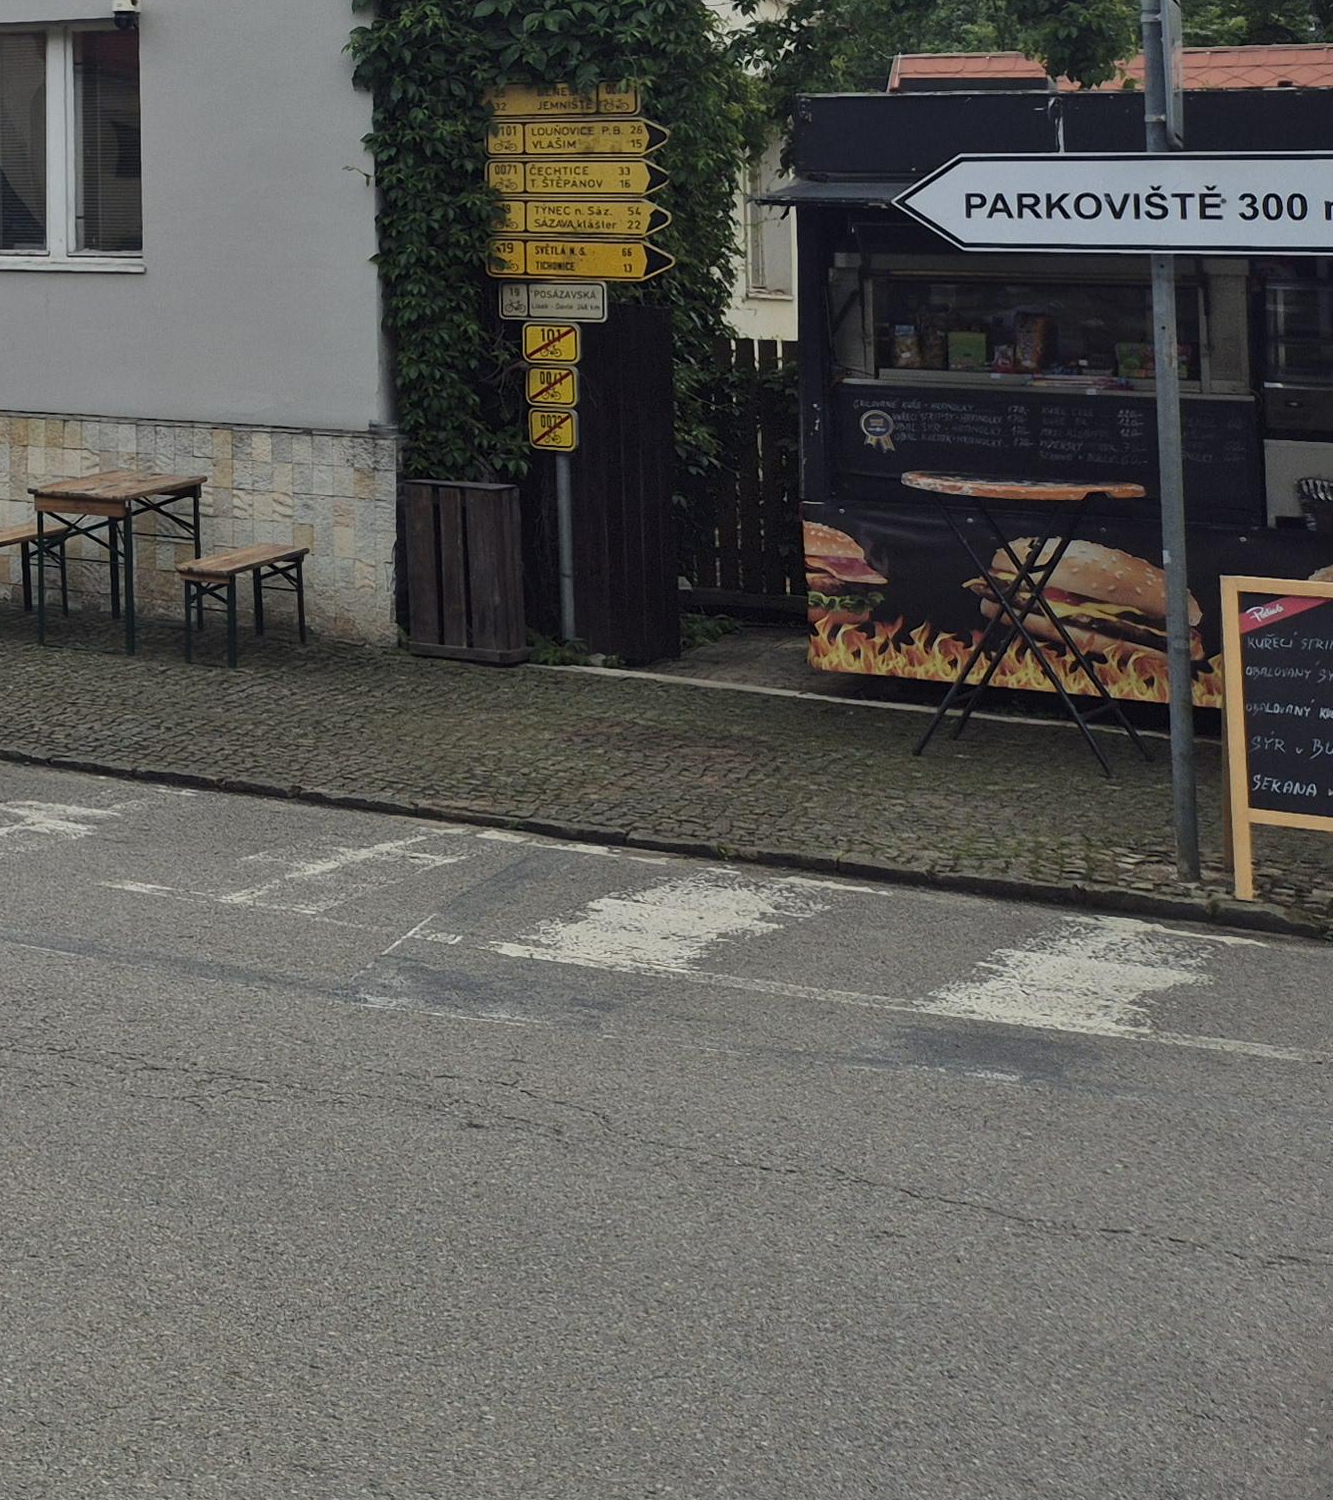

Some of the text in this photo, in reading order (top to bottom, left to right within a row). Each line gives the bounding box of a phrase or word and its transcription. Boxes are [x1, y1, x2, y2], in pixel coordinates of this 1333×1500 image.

[537, 98, 593, 111] JEMNIŠTĚ
[501, 125, 517, 136] 101
[530, 124, 595, 137] LOUŇOVICE
[630, 125, 643, 135] 26
[532, 137, 643, 149] VLAŠIM 15
[494, 164, 518, 175] 0071
[529, 163, 631, 176] ČECHTICE 33
[542, 175, 603, 188] ŠTĚPÁNOV
[620, 179, 631, 188] 16
[534, 203, 570, 216] TÝNEC
[627, 206, 641, 216] 54
[964, 185, 1225, 220] PARKOVIŠTĚ
[1238, 192, 1308, 221] 300
[627, 220, 641, 230] 22
[534, 243, 566, 256] SVĚTLÁ
[623, 263, 633, 273] 13
[509, 287, 520, 297] 19
[533, 288, 597, 300] POSÁZAVSKÁ
[541, 328, 561, 342] 101
[1247, 631, 1298, 650] KUŘECÍ
[1245, 661, 1320, 680] OBALOVANÝ
[1251, 730, 1286, 754] SÝR
[1252, 773, 1317, 797] SEKANA
